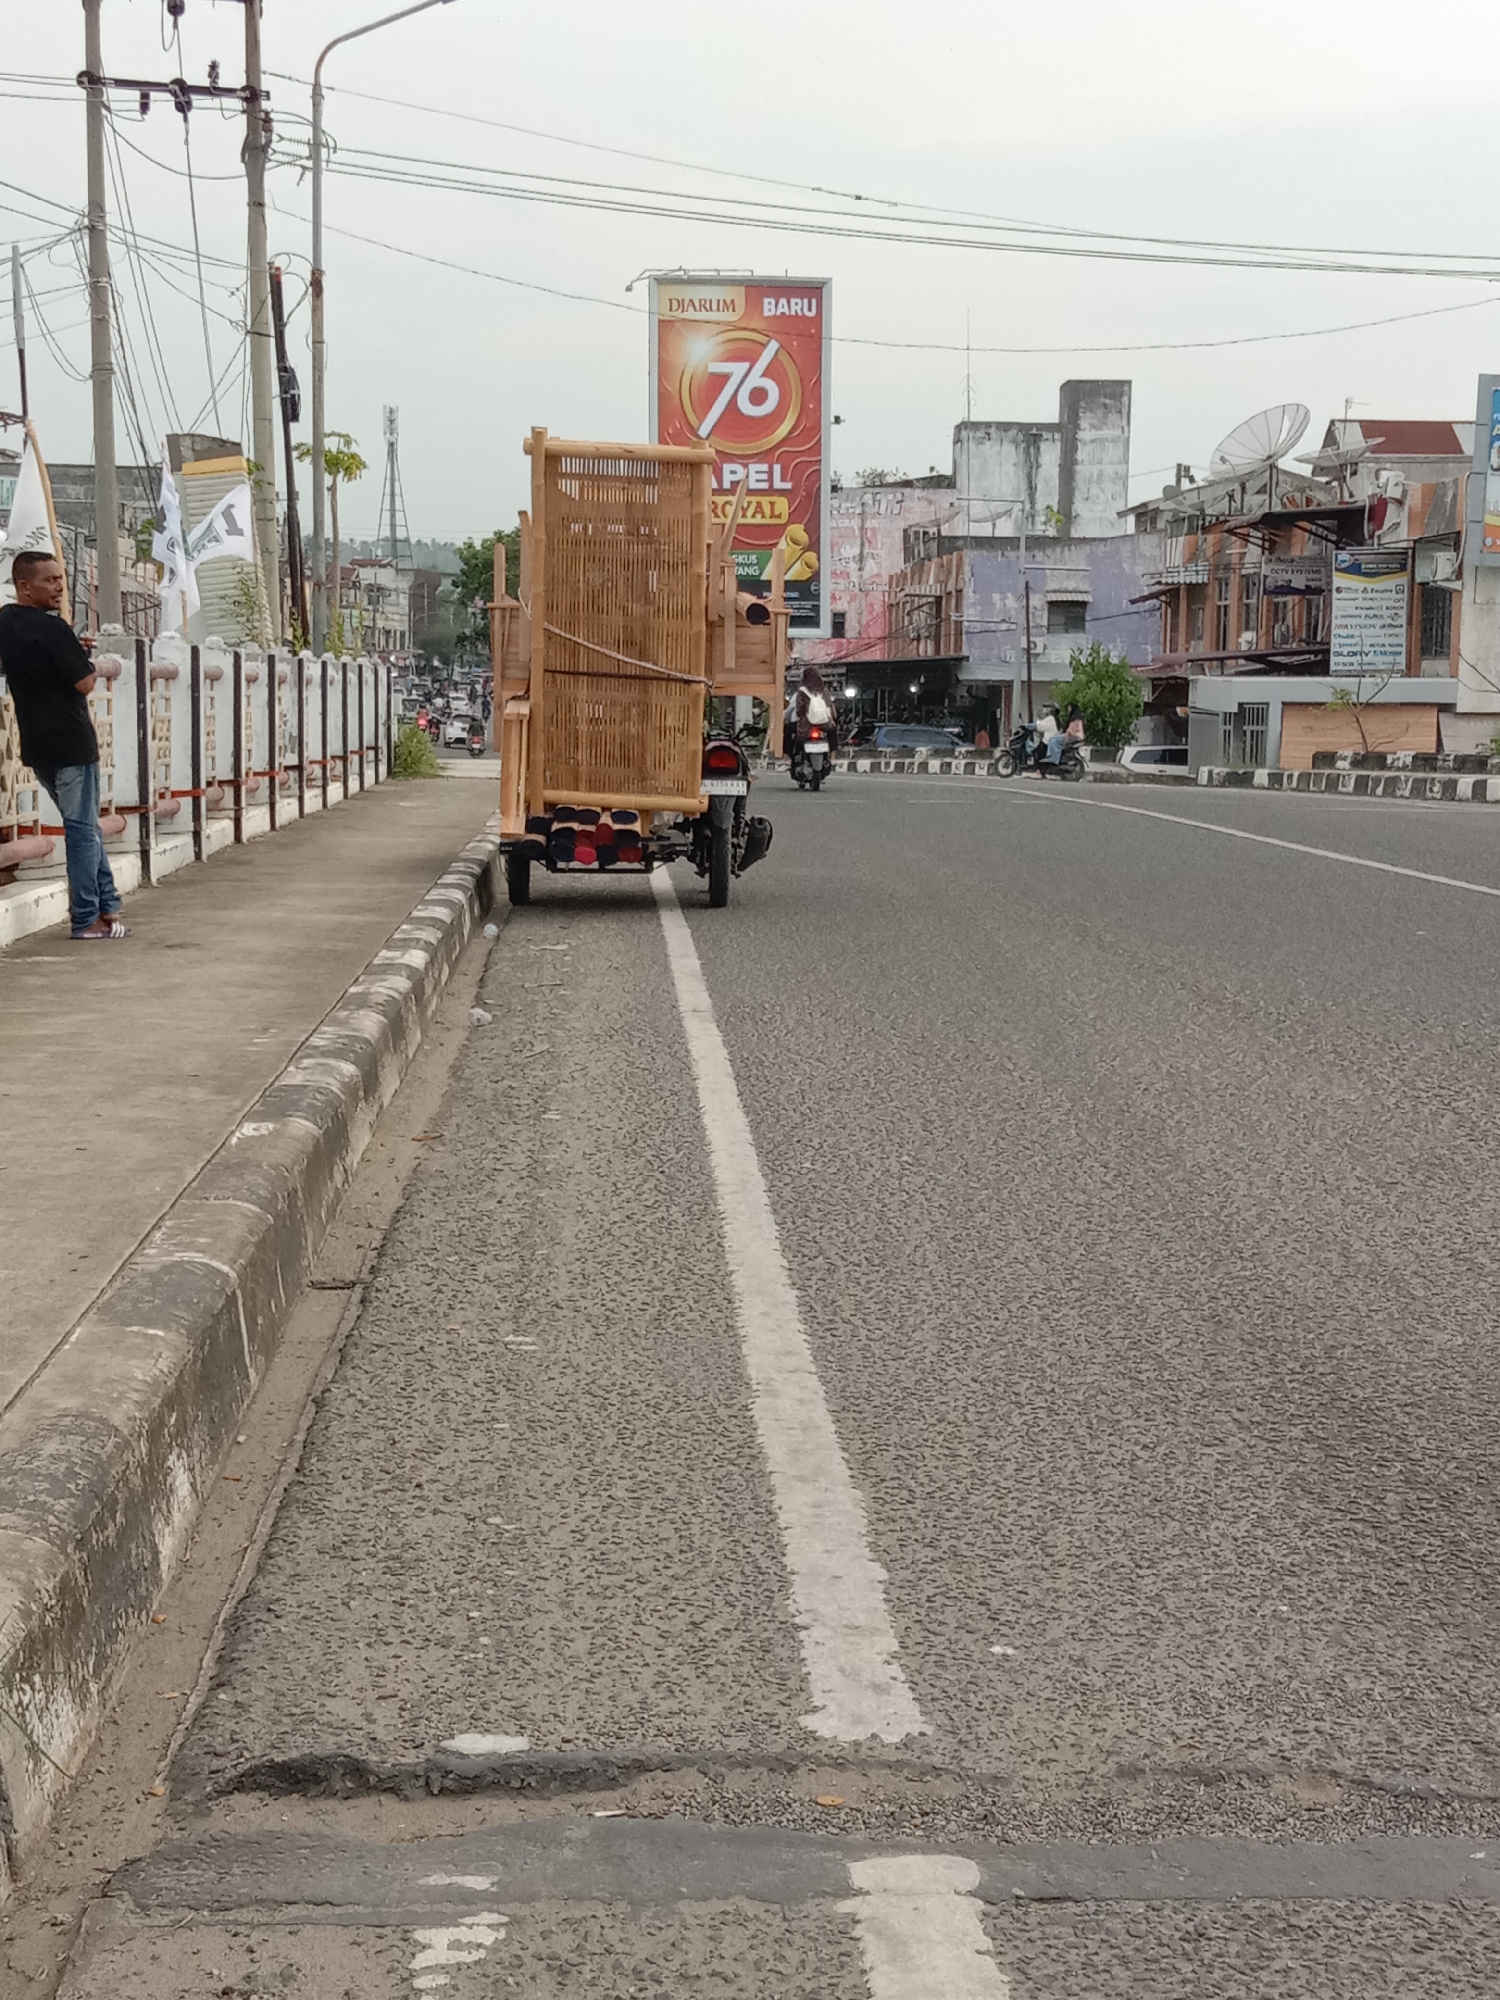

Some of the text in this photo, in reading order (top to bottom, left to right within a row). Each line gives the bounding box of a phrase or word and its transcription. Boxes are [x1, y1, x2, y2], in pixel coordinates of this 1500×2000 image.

[668, 297, 737, 314] DJARUM
[763, 297, 818, 317] BARU
[697, 338, 781, 440] 76
[711, 463, 793, 490] PEL
